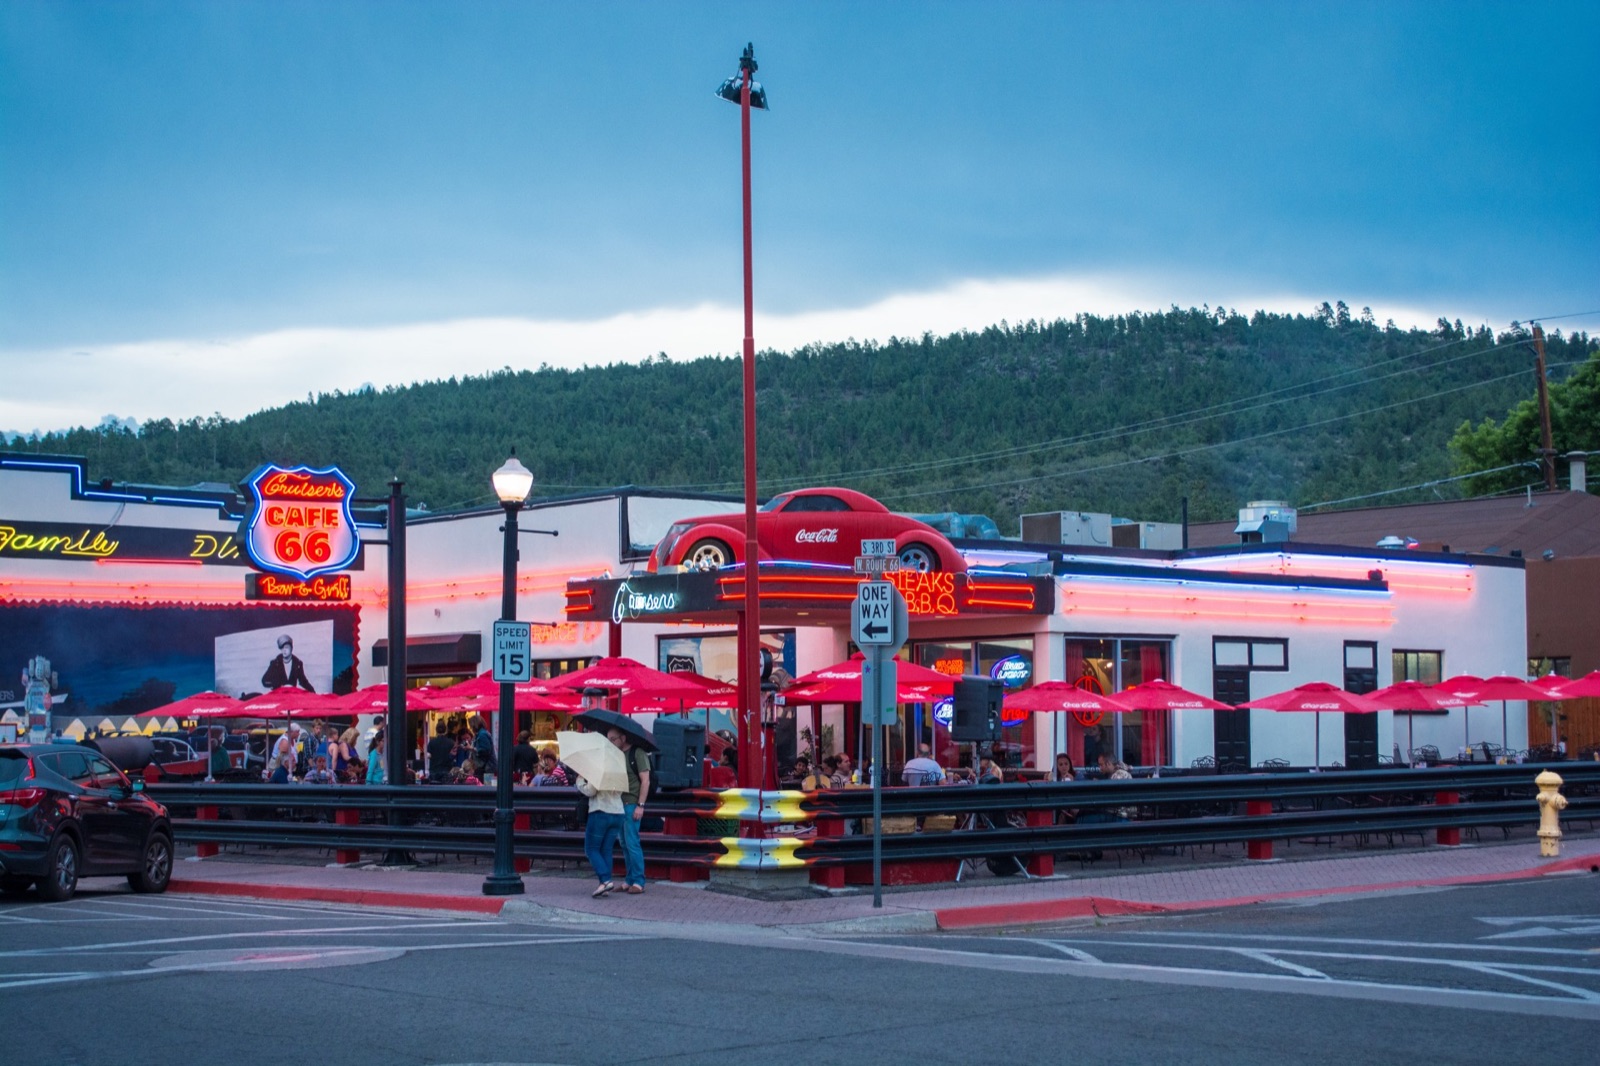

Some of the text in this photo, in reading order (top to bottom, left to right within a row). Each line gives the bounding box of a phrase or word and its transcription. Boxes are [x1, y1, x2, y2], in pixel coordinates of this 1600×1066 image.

[264, 505, 340, 528] CAFE
[795, 528, 838, 543] Coca-Cola
[274, 529, 332, 564] 66
[862, 541, 894, 554] S 3RD ST
[866, 560, 887, 571] ROUTE
[889, 560, 899, 571] 66
[262, 576, 295, 595] Bar
[884, 570, 954, 594] STEAKS
[862, 586, 888, 601] ONE
[861, 603, 889, 619] WAY
[496, 628, 528, 637] SPEED
[499, 641, 524, 650] LIMIT
[499, 653, 524, 676] 15
